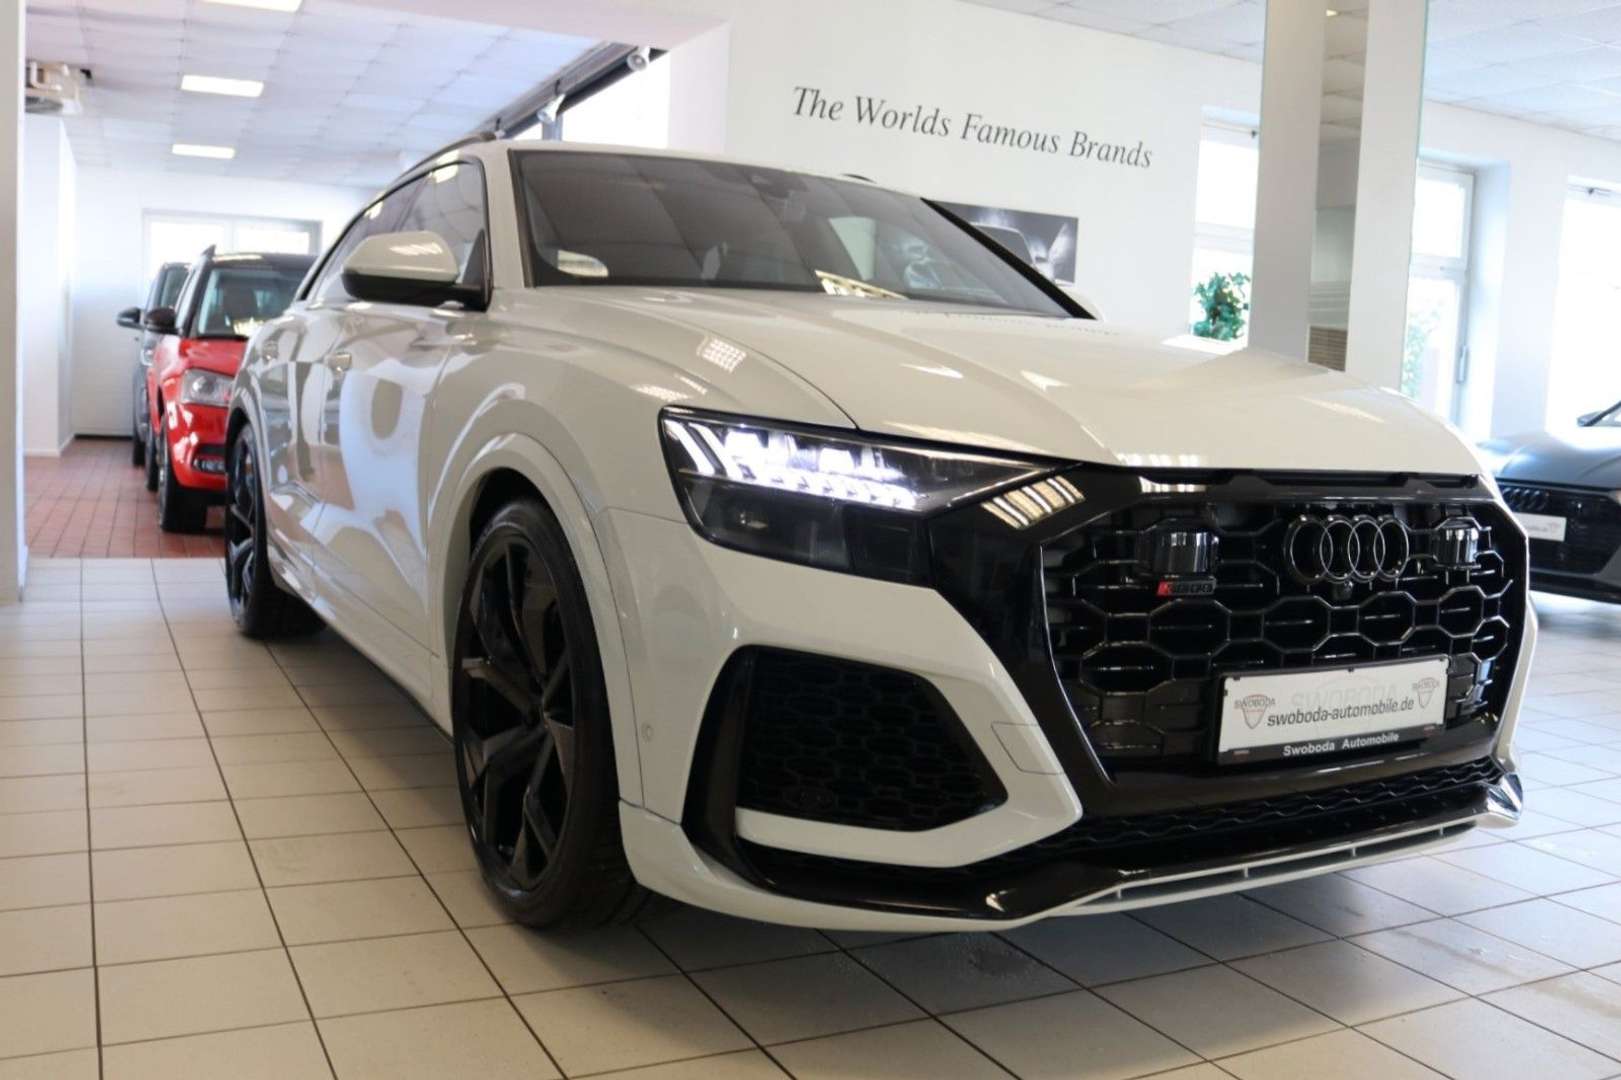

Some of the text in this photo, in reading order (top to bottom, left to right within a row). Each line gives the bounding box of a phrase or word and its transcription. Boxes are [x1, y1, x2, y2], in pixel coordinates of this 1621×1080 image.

[793, 86, 1153, 168] The Worlds Famous Brands
[1267, 696, 1415, 727] swoboda-automobile.de
[1283, 732, 1400, 757] Swoboda Automobile
